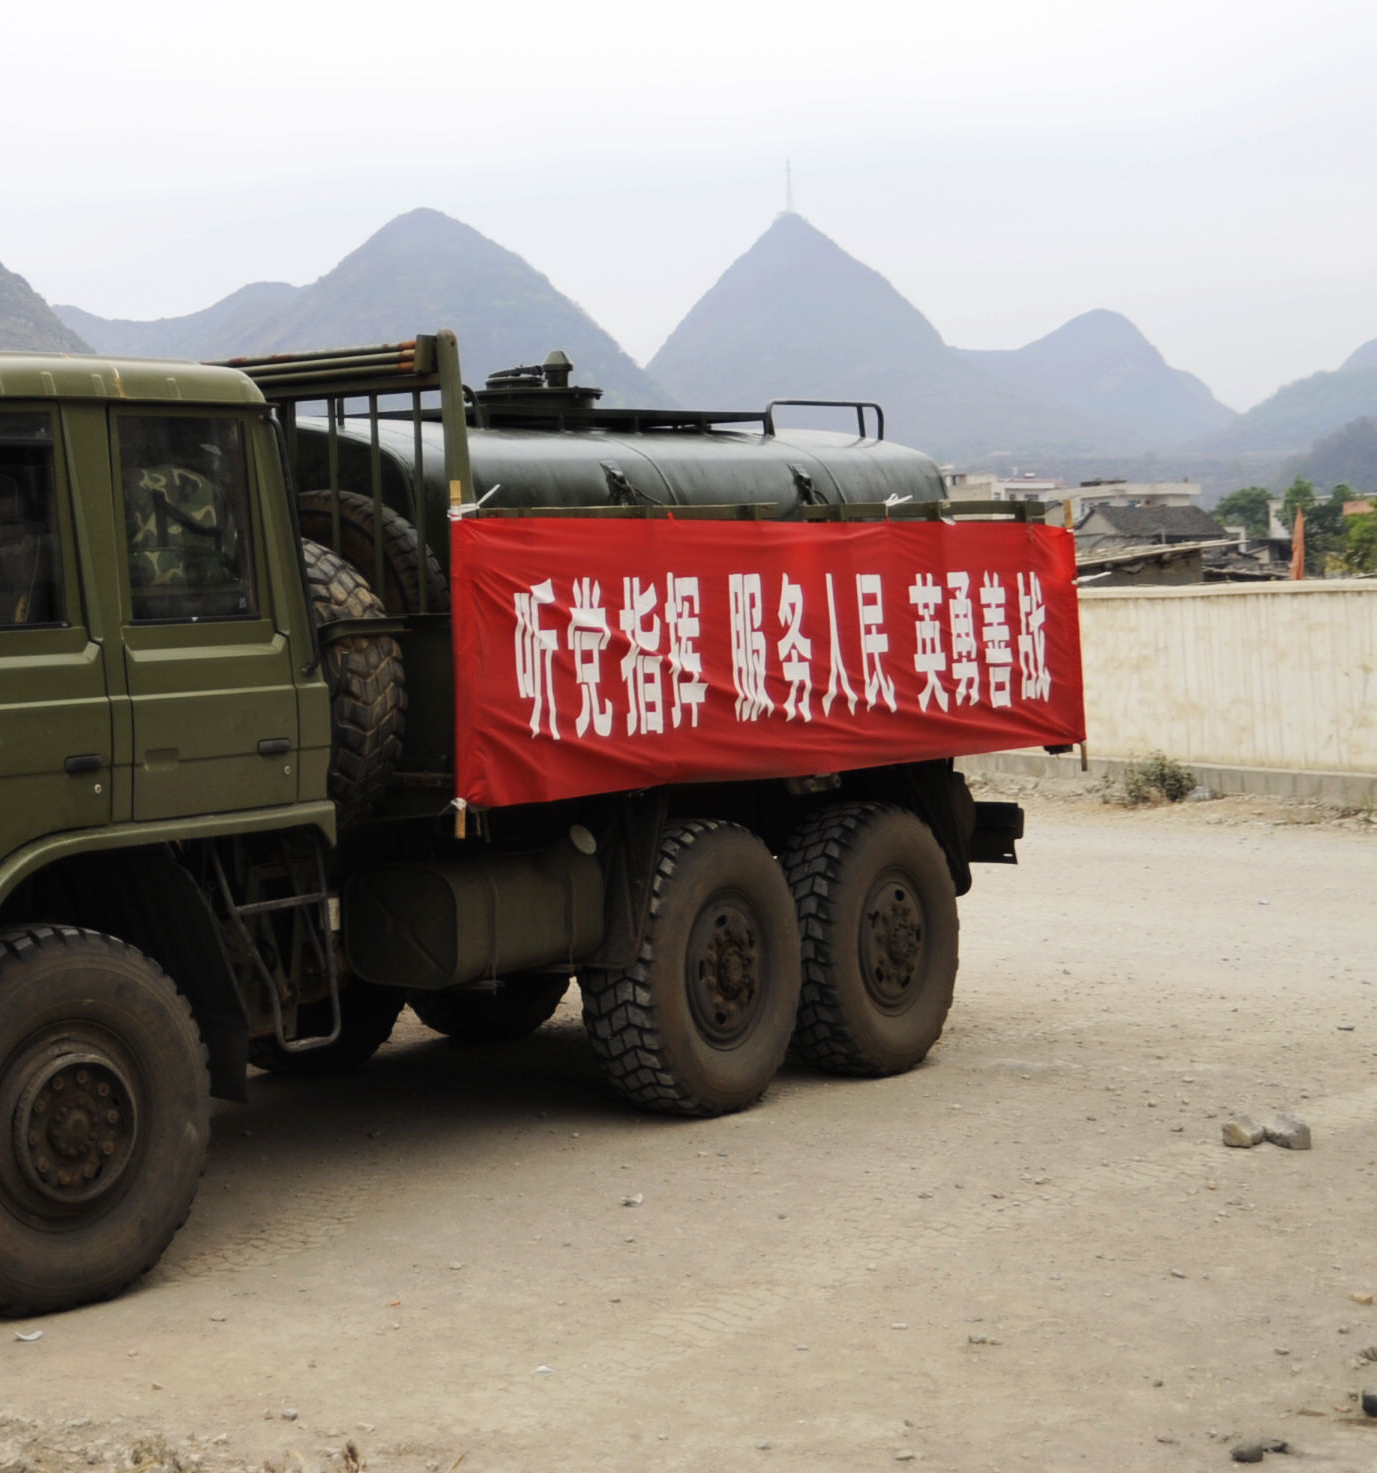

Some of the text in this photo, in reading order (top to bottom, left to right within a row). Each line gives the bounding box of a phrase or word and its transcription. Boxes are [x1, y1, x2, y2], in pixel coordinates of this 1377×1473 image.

[513, 571, 1050, 740] 听党指挥 服务人民 英勇善战
